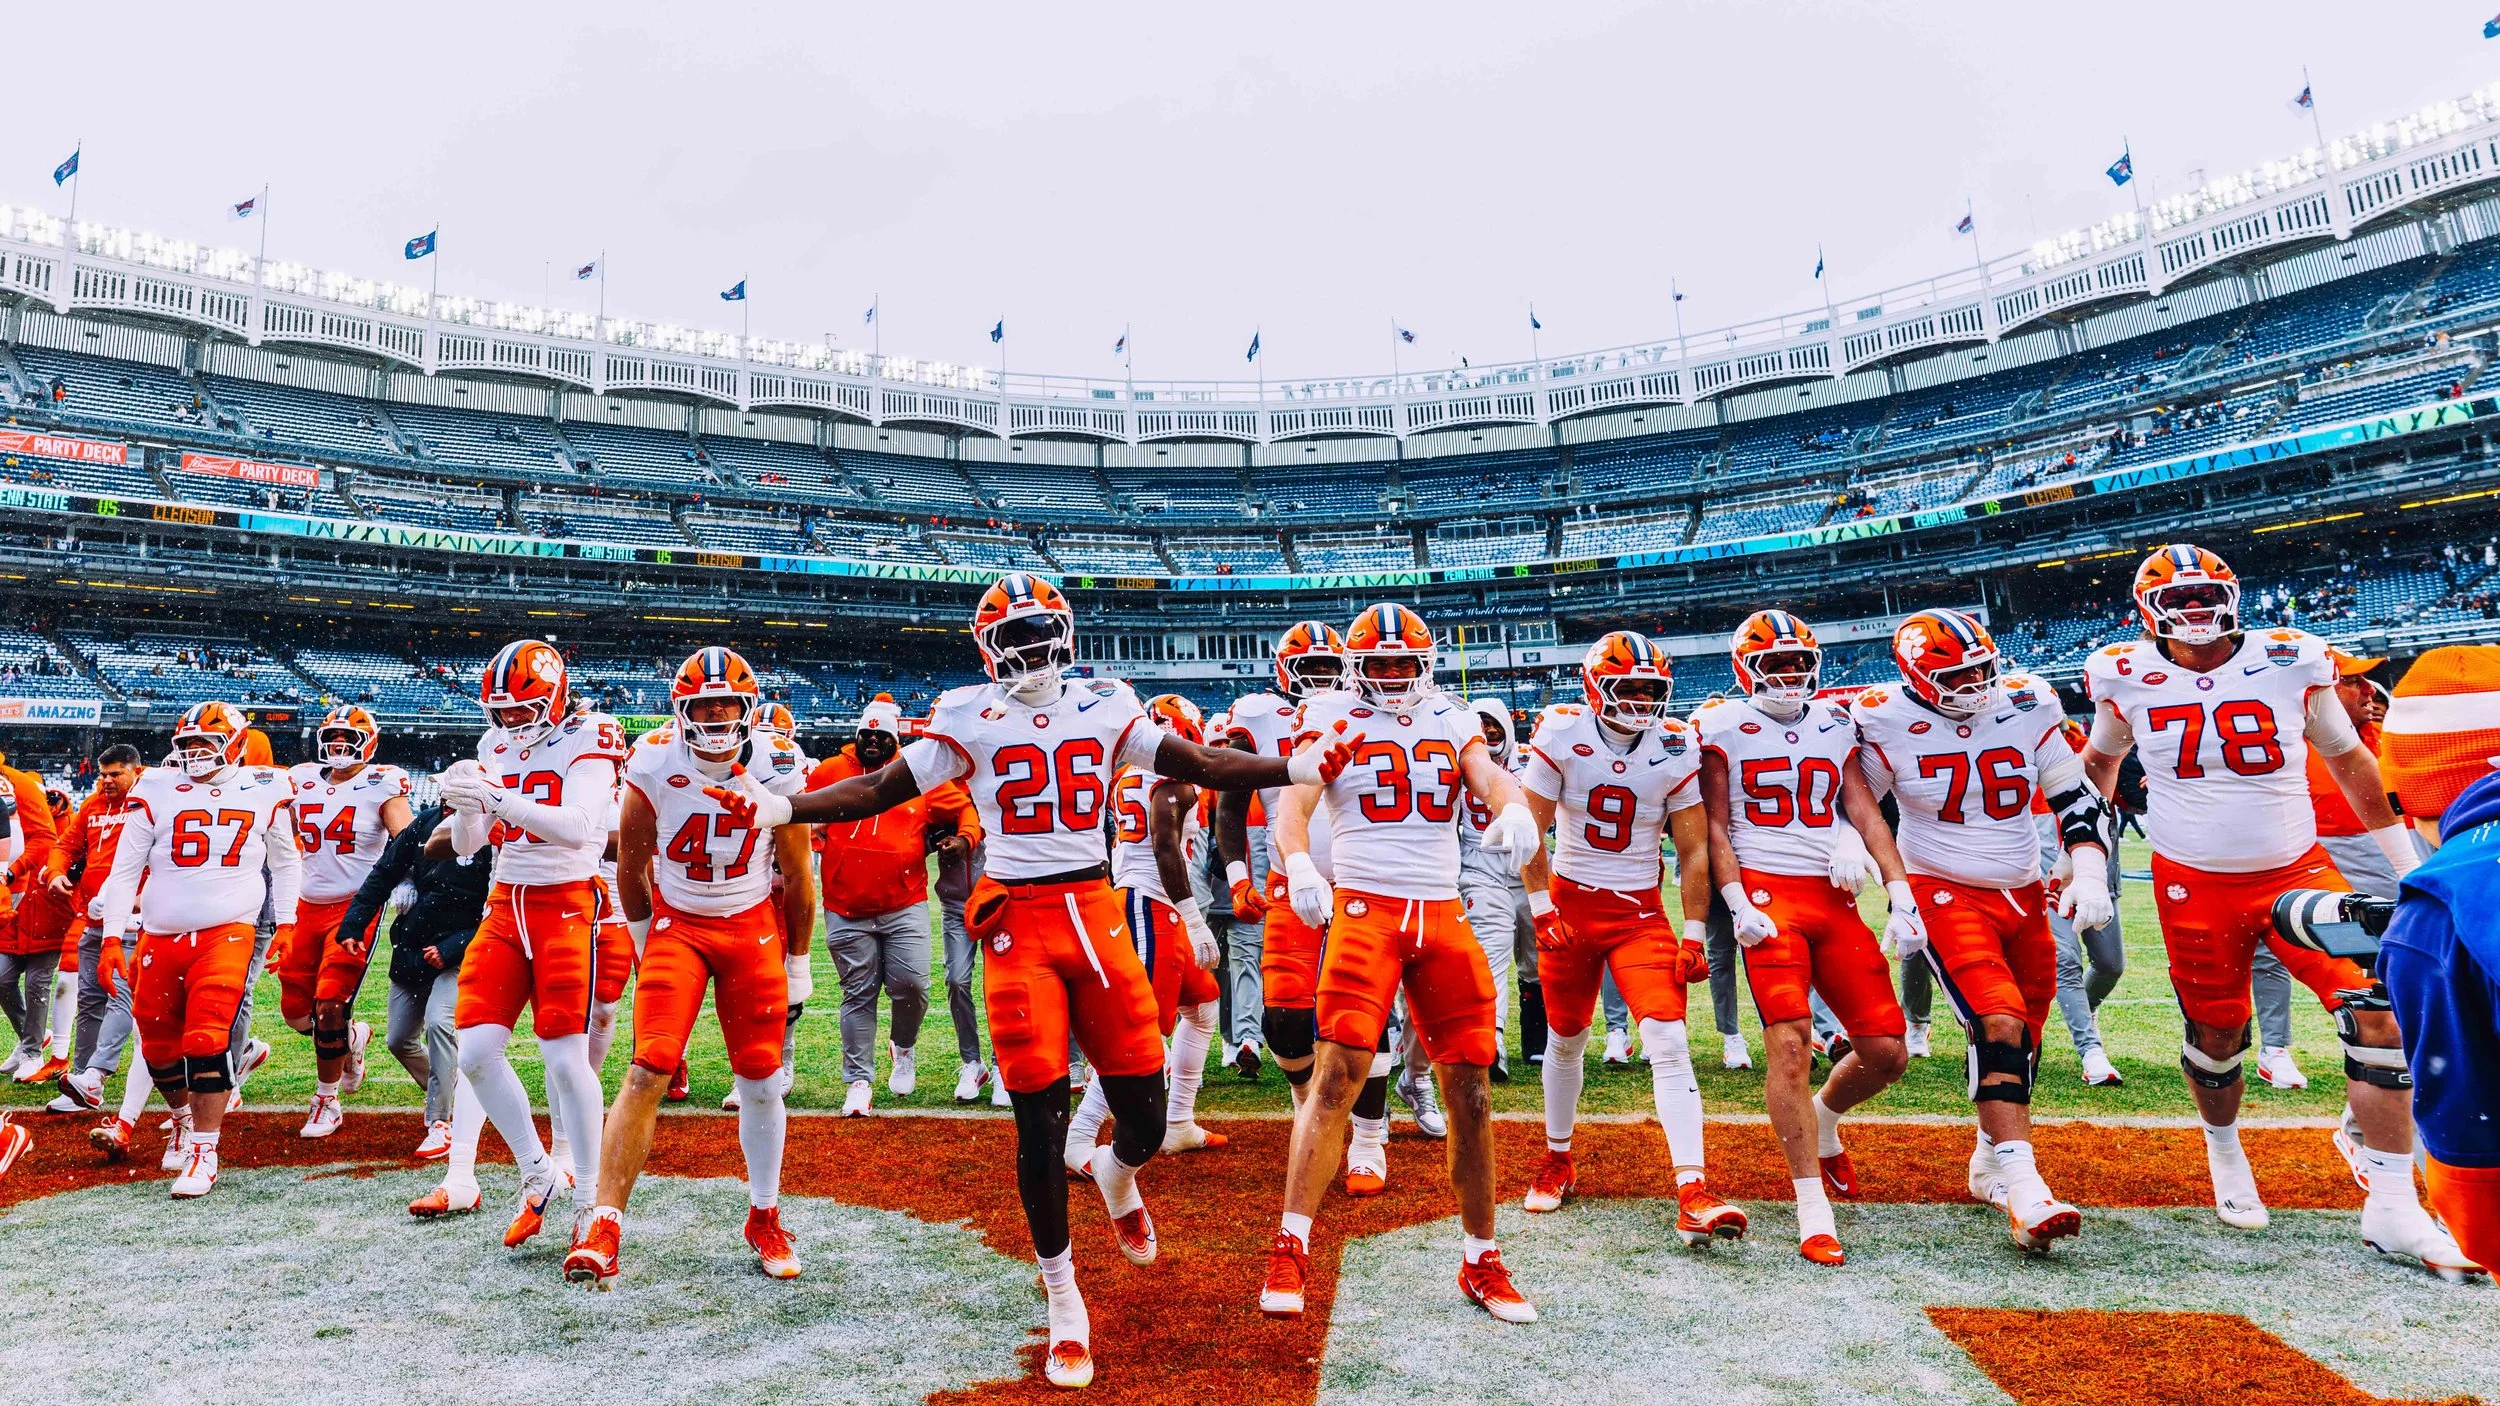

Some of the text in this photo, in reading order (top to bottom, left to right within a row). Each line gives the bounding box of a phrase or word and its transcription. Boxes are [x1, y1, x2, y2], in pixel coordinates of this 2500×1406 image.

[33, 436, 81, 457] PARTY
[82, 443, 122, 462] DECK
[239, 462, 280, 481] PARTY
[281, 468, 315, 486] DECK
[26, 492, 70, 511] STATE
[153, 504, 215, 526] CLEMSON
[1913, 511, 1940, 528] PENN
[1940, 506, 1968, 524] STATE
[2024, 484, 2074, 507] CLEMSON
[579, 545, 604, 560] PENN
[606, 547, 636, 561] STATE
[697, 553, 743, 568] CLEMSON
[1115, 577, 1155, 590] CLEMSON
[1444, 569, 1467, 582] PENN
[1468, 566, 1496, 580] STATE
[1553, 559, 1598, 574] CLEMSON
[1425, 604, 1544, 619] 27-Time World Champions
[1860, 622, 1887, 631] DELTA
[2116, 657, 2132, 676] C
[2145, 673, 2164, 682] ACC
[26, 705, 97, 719] AMAZING
[597, 723, 625, 750] 53
[1912, 722, 1928, 732] ACC
[2146, 699, 2286, 780] 78
[1575, 745, 1591, 753] ACC
[992, 736, 1106, 835] 26
[1353, 738, 1462, 823] 33
[1740, 757, 1840, 827] 50
[1916, 745, 2031, 824] 76
[87, 812, 129, 828] CLEMSO
[299, 803, 356, 855] 54
[1583, 783, 1638, 853] 9
[171, 808, 256, 867] 67
[666, 810, 763, 883] 47
